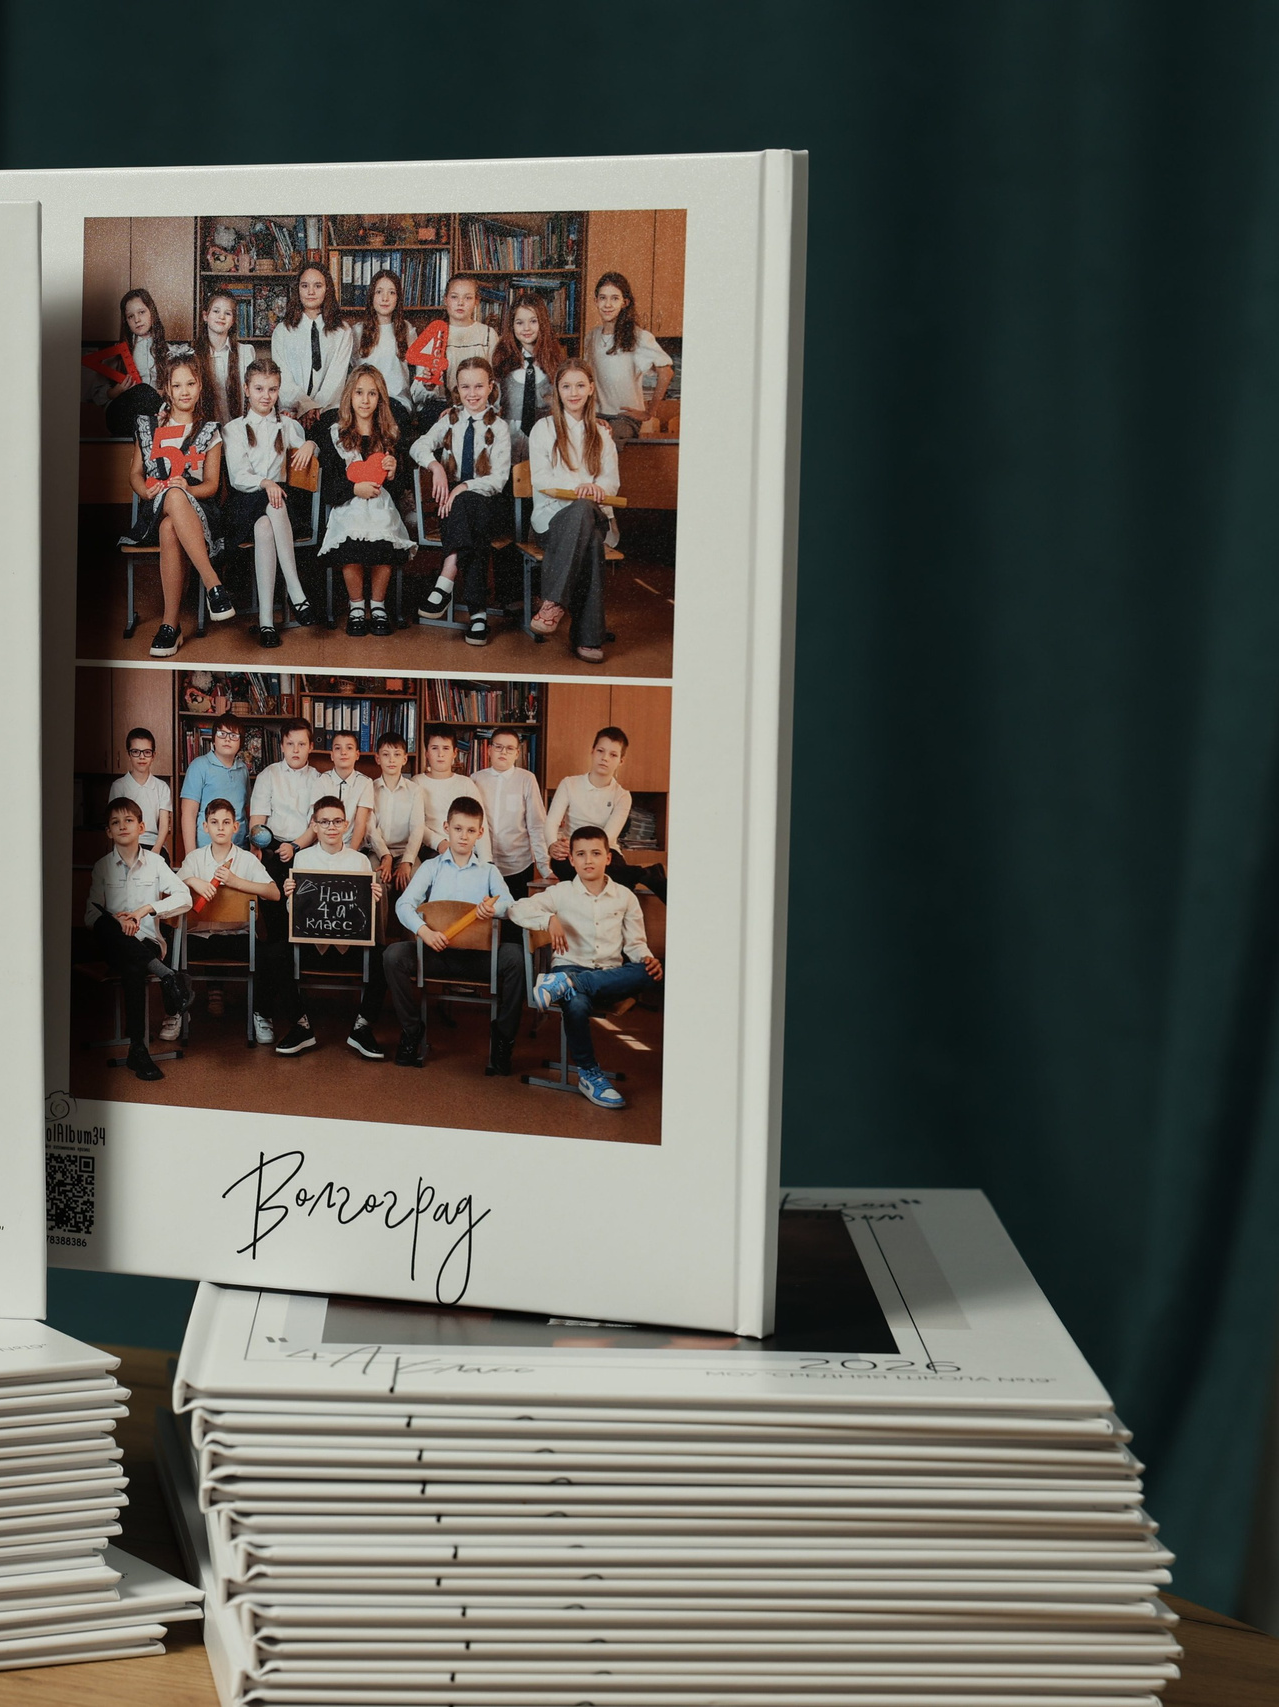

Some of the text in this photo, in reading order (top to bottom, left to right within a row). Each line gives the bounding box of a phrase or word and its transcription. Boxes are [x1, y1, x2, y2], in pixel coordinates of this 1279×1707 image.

[319, 885, 354, 902] Наш
[45, 1122, 106, 1146] olAlbum34
[221, 1150, 492, 1306] Волгоград
[46, 1234, 87, 1248] 78388386
[799, 1357, 962, 1373] 2026
